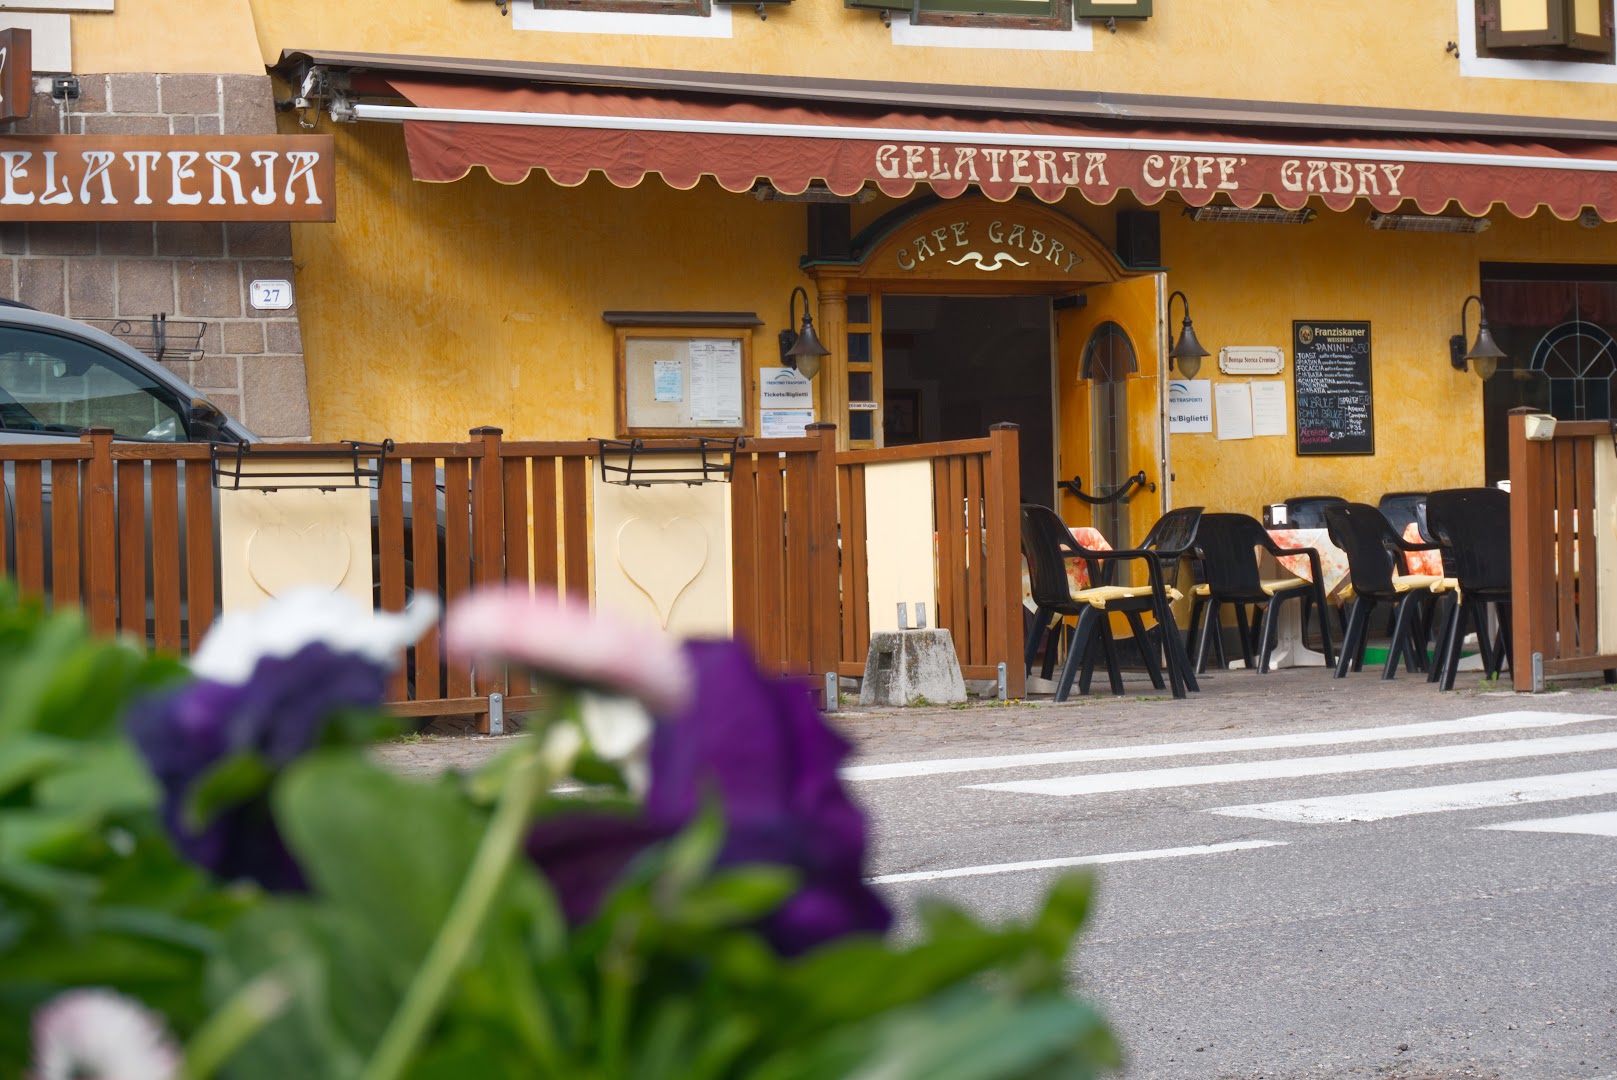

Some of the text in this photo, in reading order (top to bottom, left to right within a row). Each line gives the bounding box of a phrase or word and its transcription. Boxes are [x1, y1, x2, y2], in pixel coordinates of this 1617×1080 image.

[1280, 160, 1405, 196] GABRY
[988, 221, 1084, 273] GABRY
[262, 289, 280, 302] 27
[1314, 327, 1365, 336] Franziskaner
